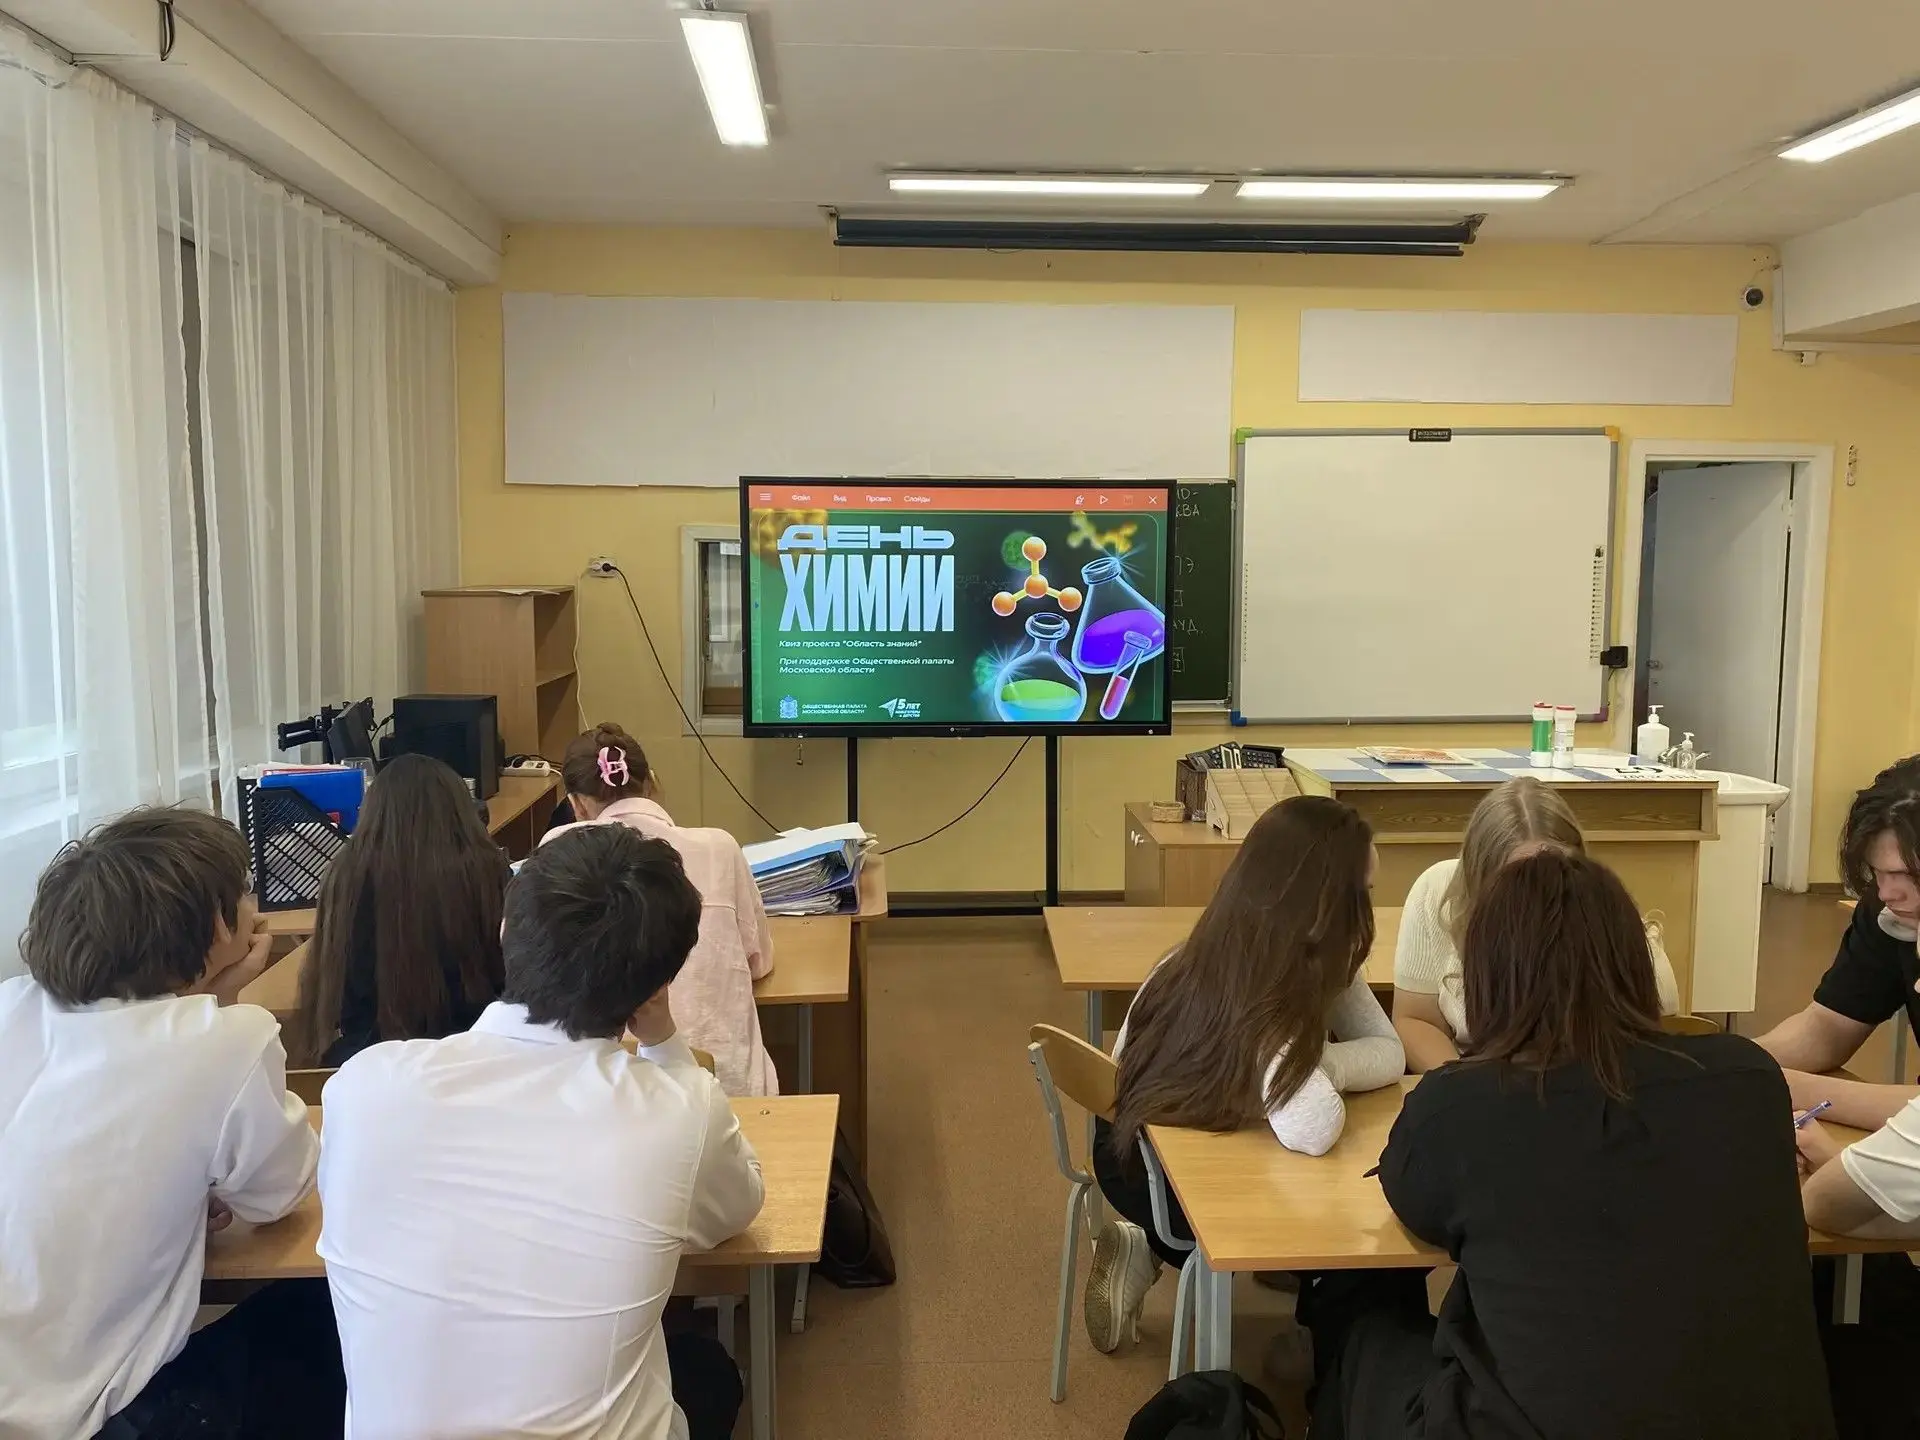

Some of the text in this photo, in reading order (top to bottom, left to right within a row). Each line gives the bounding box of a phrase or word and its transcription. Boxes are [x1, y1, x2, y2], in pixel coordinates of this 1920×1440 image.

[833, 494, 847, 502] Вид
[865, 494, 892, 502] Правка
[903, 495, 931, 503] Слайды
[777, 525, 955, 550] ДЕНЬ
[778, 554, 955, 631] ХИМИИ
[779, 640, 922, 649] Квиз проекта "Область знаний"
[779, 658, 799, 666] При
[852, 658, 921, 666] Общественной
[779, 666, 875, 674] Московской области
